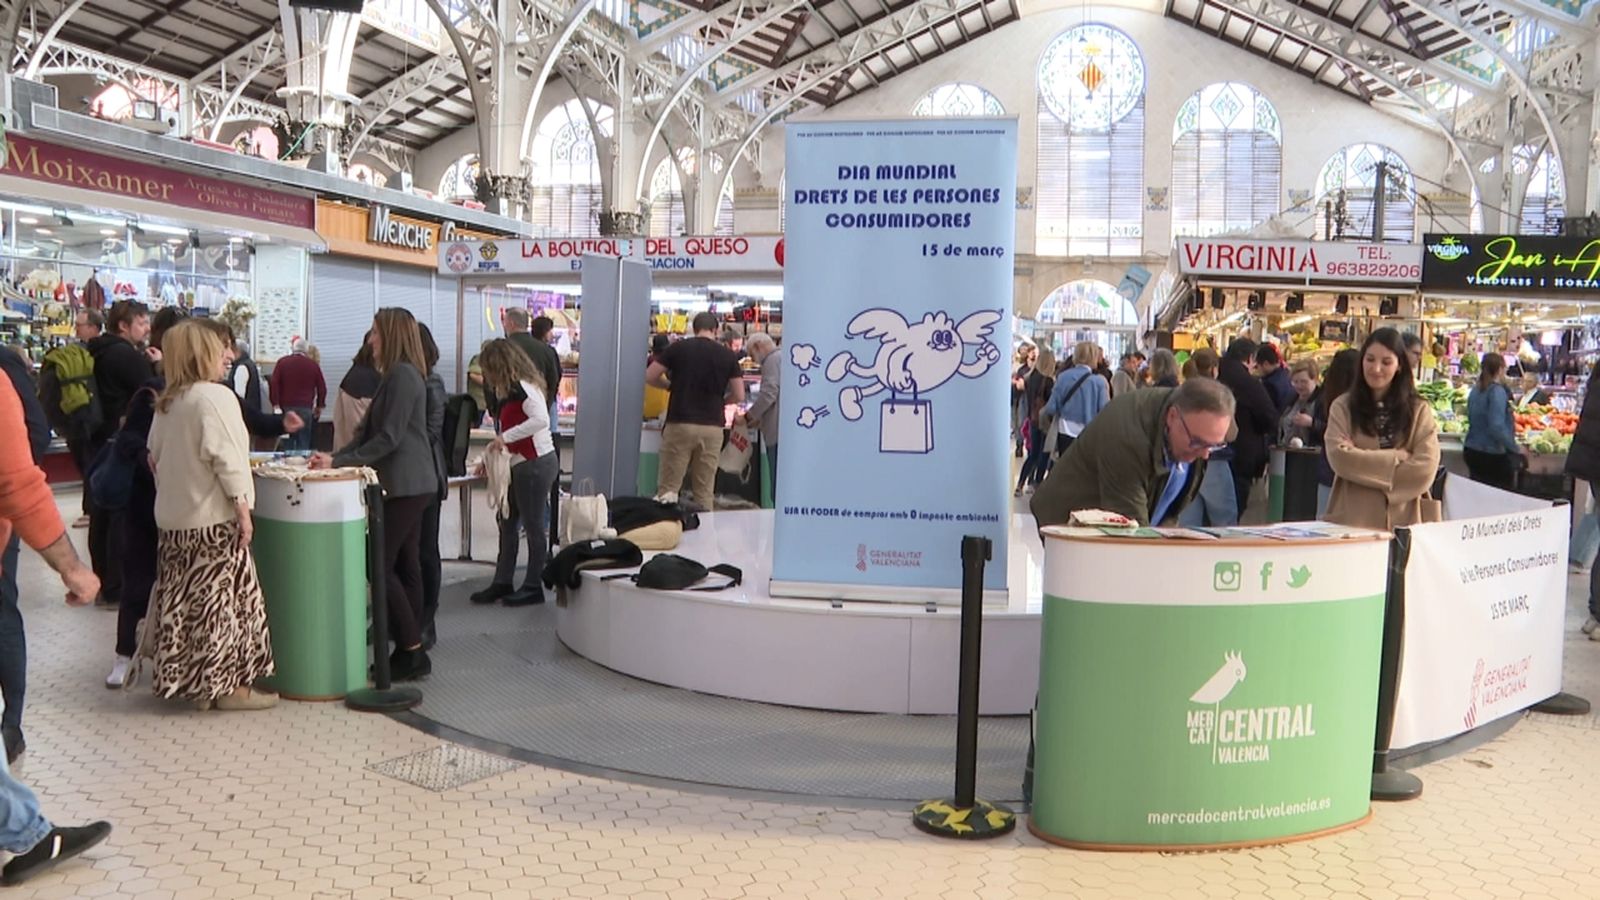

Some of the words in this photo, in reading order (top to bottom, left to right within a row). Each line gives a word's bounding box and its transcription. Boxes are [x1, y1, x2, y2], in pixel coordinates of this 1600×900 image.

[5, 141, 174, 200] Moixamer
[838, 165, 870, 180] DIA
[876, 164, 957, 180] MUNDIAL
[233, 187, 246, 199] de
[794, 189, 848, 204] DRETS
[854, 189, 877, 204] DE
[883, 188, 908, 204] LES
[913, 188, 1001, 204] PERSONES
[197, 192, 240, 209] Olives
[252, 202, 295, 218] Fumats
[373, 206, 434, 250] MERCHE
[825, 213, 972, 228] CONSUMIDORES
[521, 240, 543, 258] LA
[646, 238, 676, 256] DEL
[685, 237, 749, 256] QUESO
[922, 243, 938, 256] 15
[943, 243, 962, 256] de
[967, 246, 1004, 258] març
[1357, 246, 1392, 260] TEL:
[1184, 243, 1320, 272] VIRGINIA
[1326, 262, 1421, 278] 963829206
[1466, 275, 1532, 287] VERDURES
[784, 506, 799, 515] USA
[801, 507, 809, 516] EL
[810, 507, 840, 516] PODER
[841, 508, 852, 517] de
[890, 510, 908, 519] amb
[1477, 518, 1507, 537] Mundial
[1523, 514, 1542, 531] Drets
[870, 550, 922, 559] GENERALITAT
[870, 560, 921, 568] VALENCIANA
[1474, 562, 1506, 580] Persones
[1507, 551, 1559, 573] Consumidores
[1499, 599, 1509, 617] DE
[1484, 655, 1532, 687] GENERALITAT
[1187, 710, 1214, 728] MER
[1218, 703, 1316, 743] CENTRAL
[1189, 727, 1213, 745] CAT
[1148, 797, 1331, 825] mercadocentralvalencia.es
